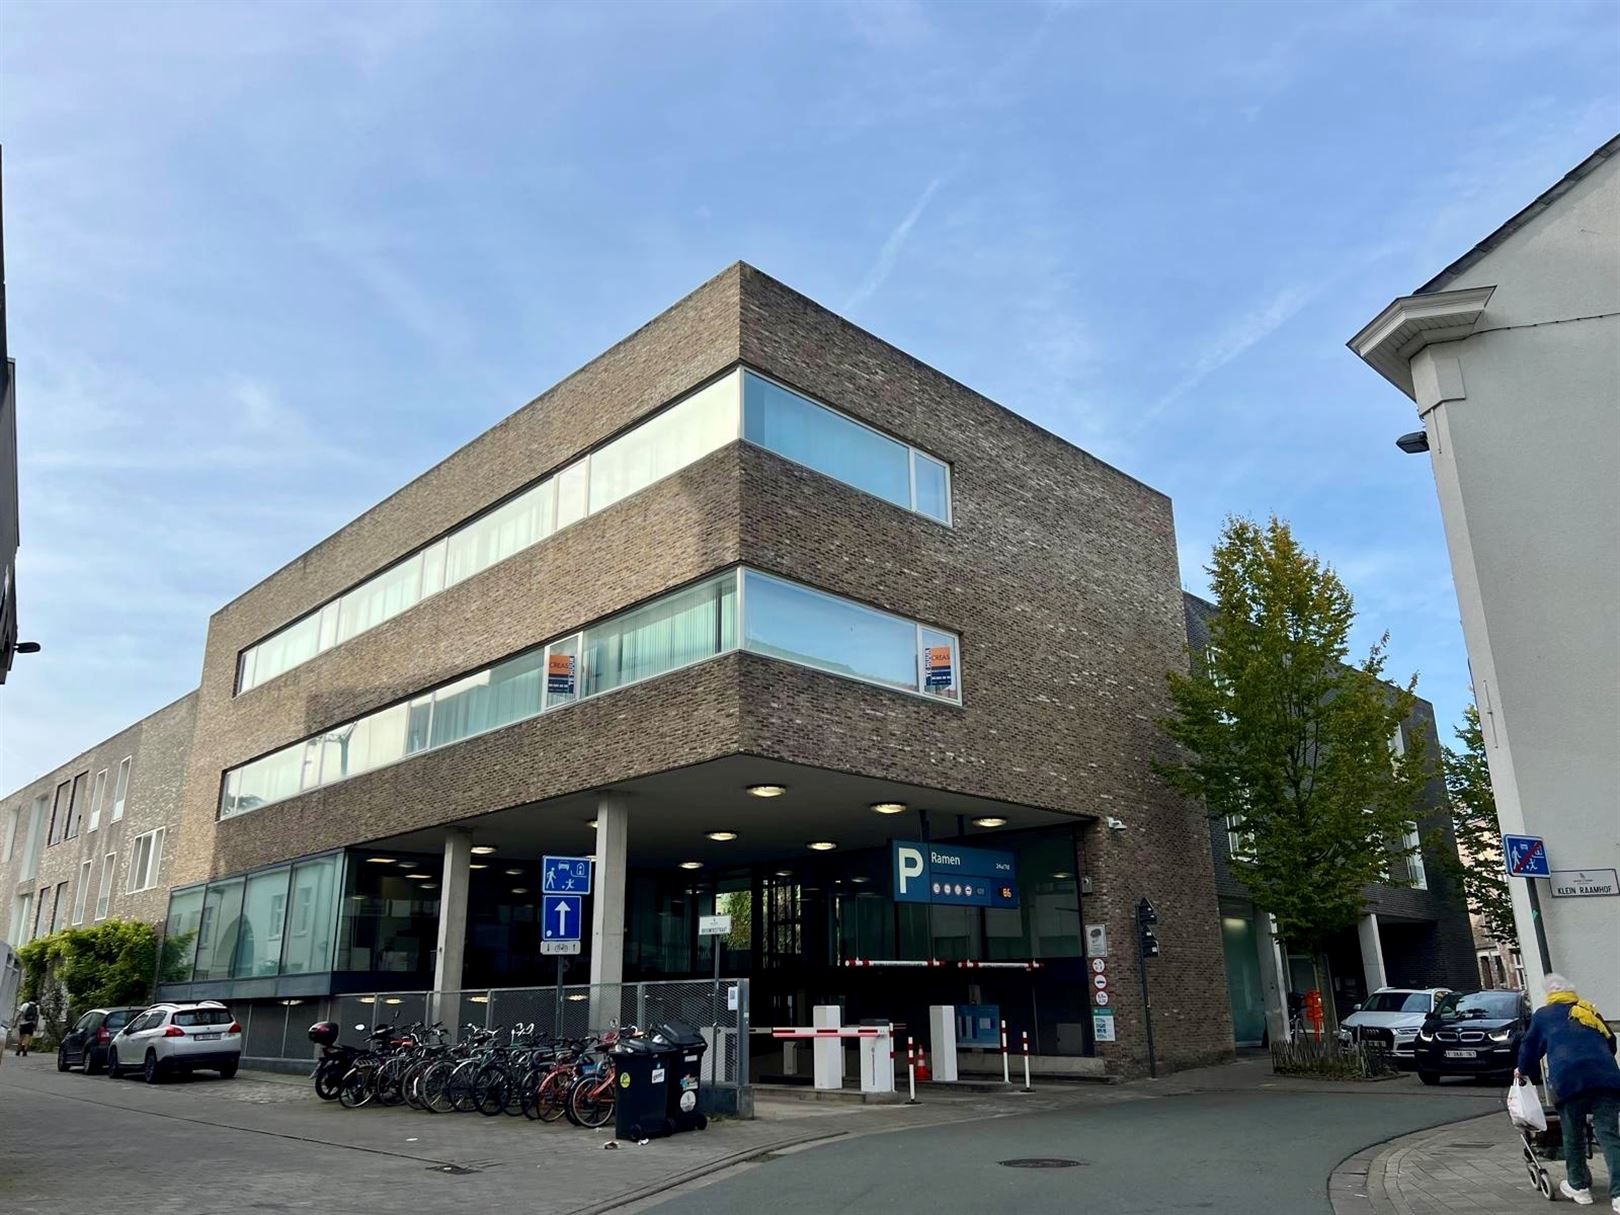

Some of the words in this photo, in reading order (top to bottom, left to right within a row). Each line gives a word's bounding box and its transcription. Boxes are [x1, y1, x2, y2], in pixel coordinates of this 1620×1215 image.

[931, 851, 961, 866] Ramen
[898, 847, 924, 894] P
[1557, 886, 1577, 894] KLEIN
[1579, 885, 1612, 894] RAAMHOF
